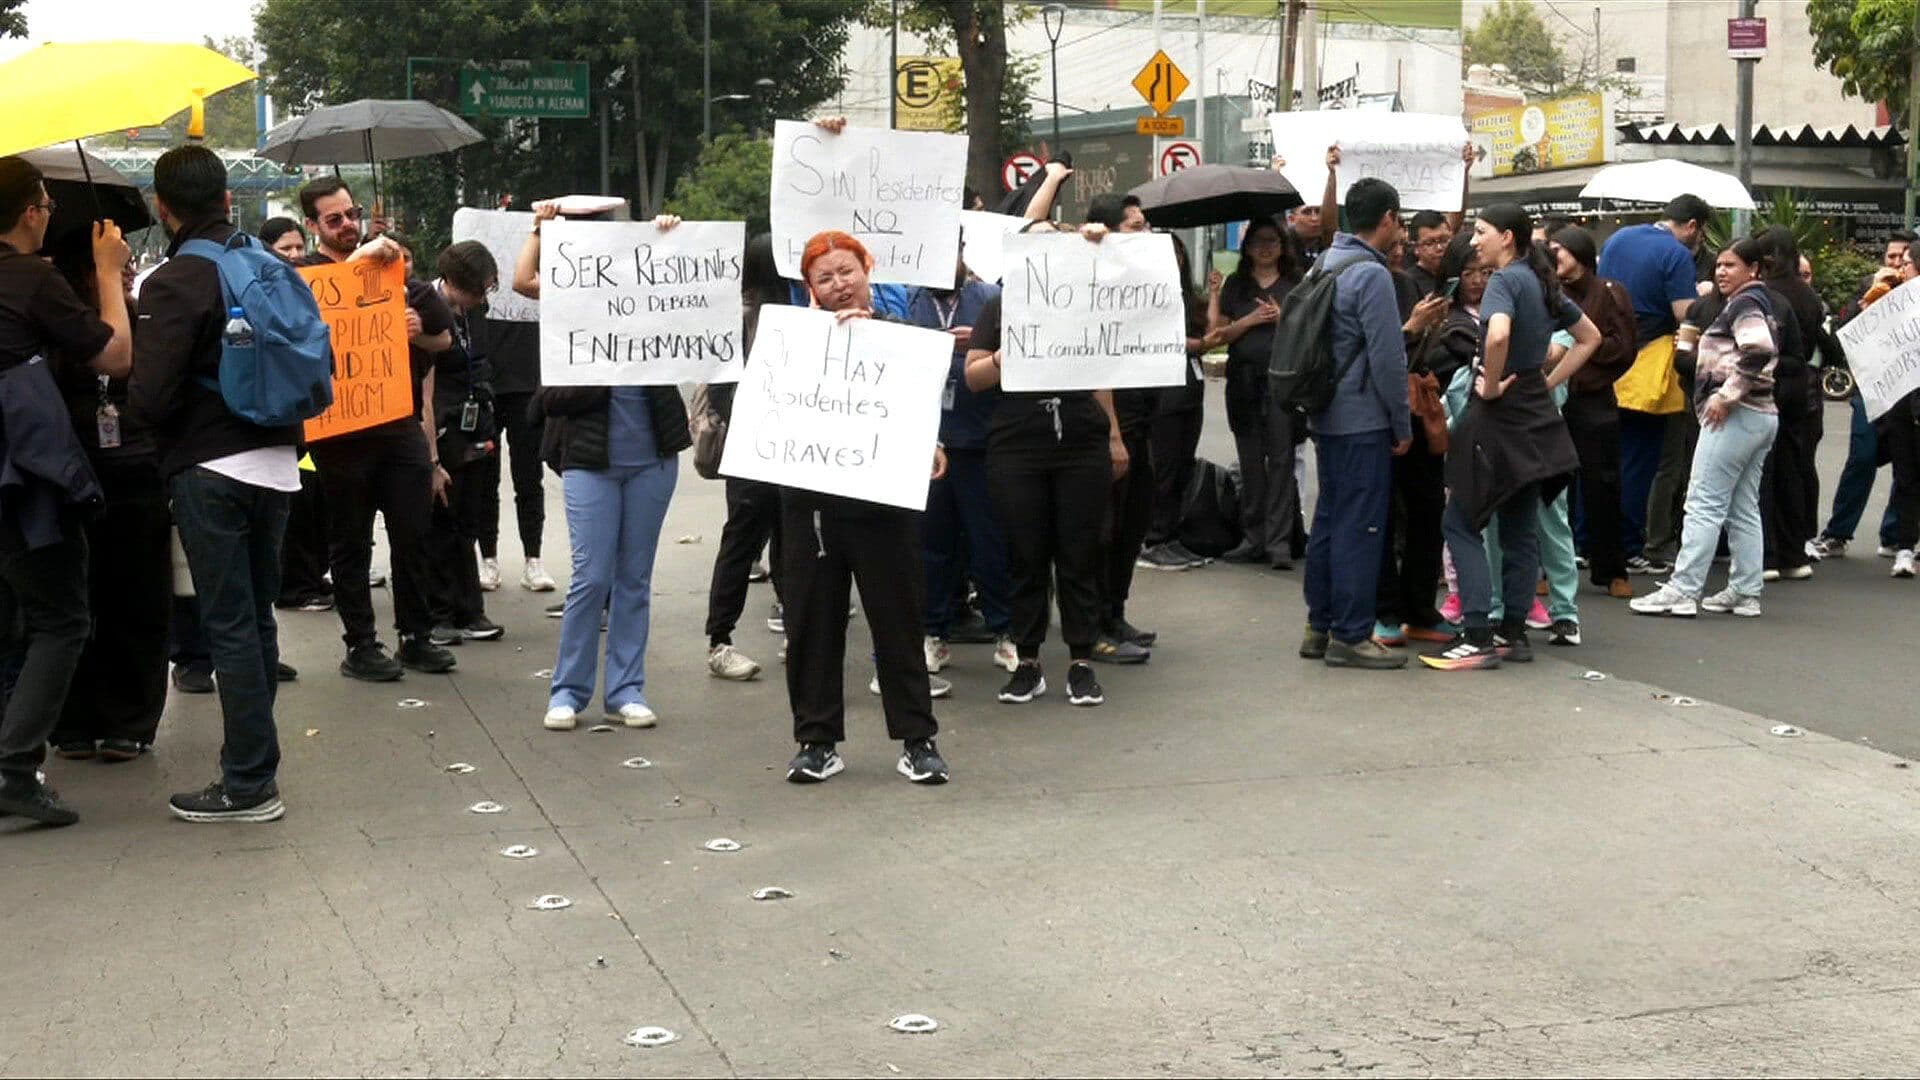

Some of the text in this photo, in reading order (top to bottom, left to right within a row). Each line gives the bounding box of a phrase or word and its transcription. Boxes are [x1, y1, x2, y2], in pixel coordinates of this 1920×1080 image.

[533, 77, 576, 91] MUNDIAL
[537, 97, 545, 109] M
[869, 146, 962, 204] Residentes
[853, 208, 902, 235] NO
[552, 241, 618, 289] SER
[789, 238, 923, 273] Hpital
[608, 296, 636, 317] NO
[335, 311, 394, 347] PILAR
[1007, 323, 1044, 359] NI
[1098, 321, 1123, 357] NI
[371, 348, 394, 378] EN
[569, 329, 735, 365] ENFERMARNOS
